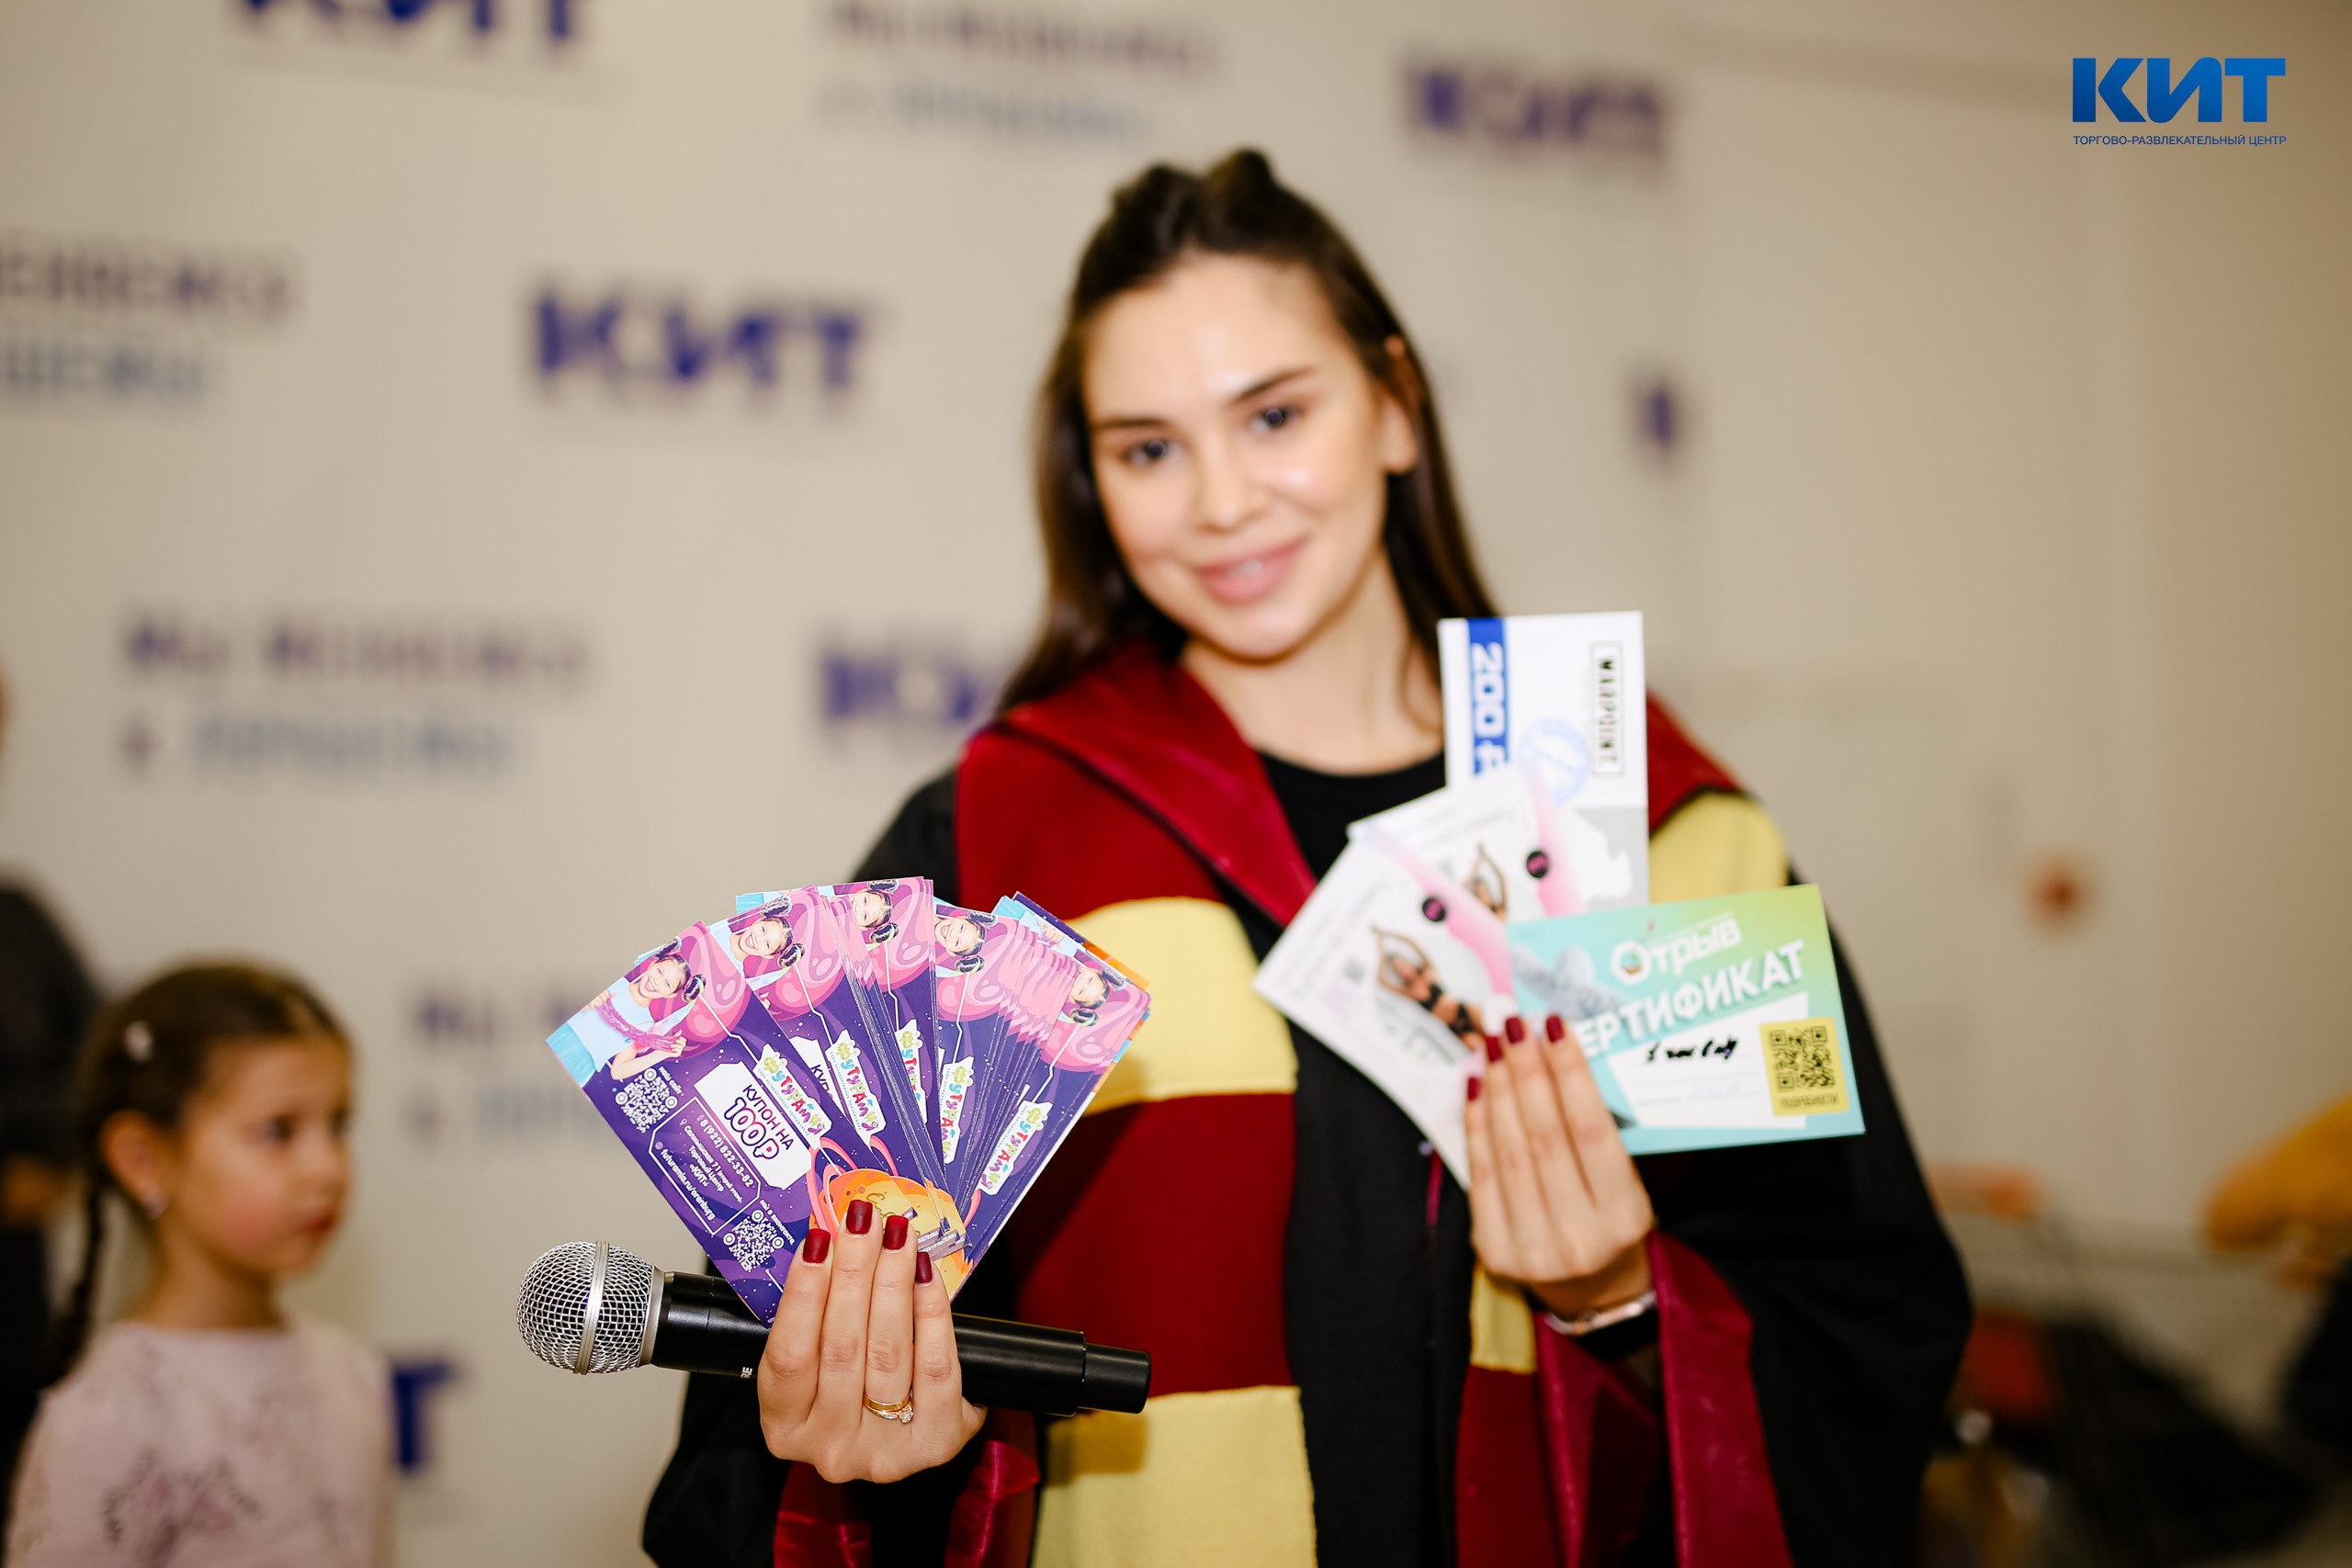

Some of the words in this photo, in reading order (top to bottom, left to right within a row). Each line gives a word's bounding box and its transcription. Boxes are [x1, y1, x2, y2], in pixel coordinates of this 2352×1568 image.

[1472, 641, 1504, 739] 200
[1598, 656, 1617, 764] WARPOINT
[699, 1118, 709, 1128] 8
[703, 1124, 725, 1149] (922)
[741, 1084, 781, 1131] КУПОН
[775, 1128, 793, 1151] НА
[660, 1149, 717, 1221] futuramia.ru/orenburg
[686, 1145, 713, 1176] Торговый
[706, 1171, 726, 1193] Центр
[687, 1162, 711, 1189] «КИТ»
[718, 1145, 755, 1188] 822-33-82
